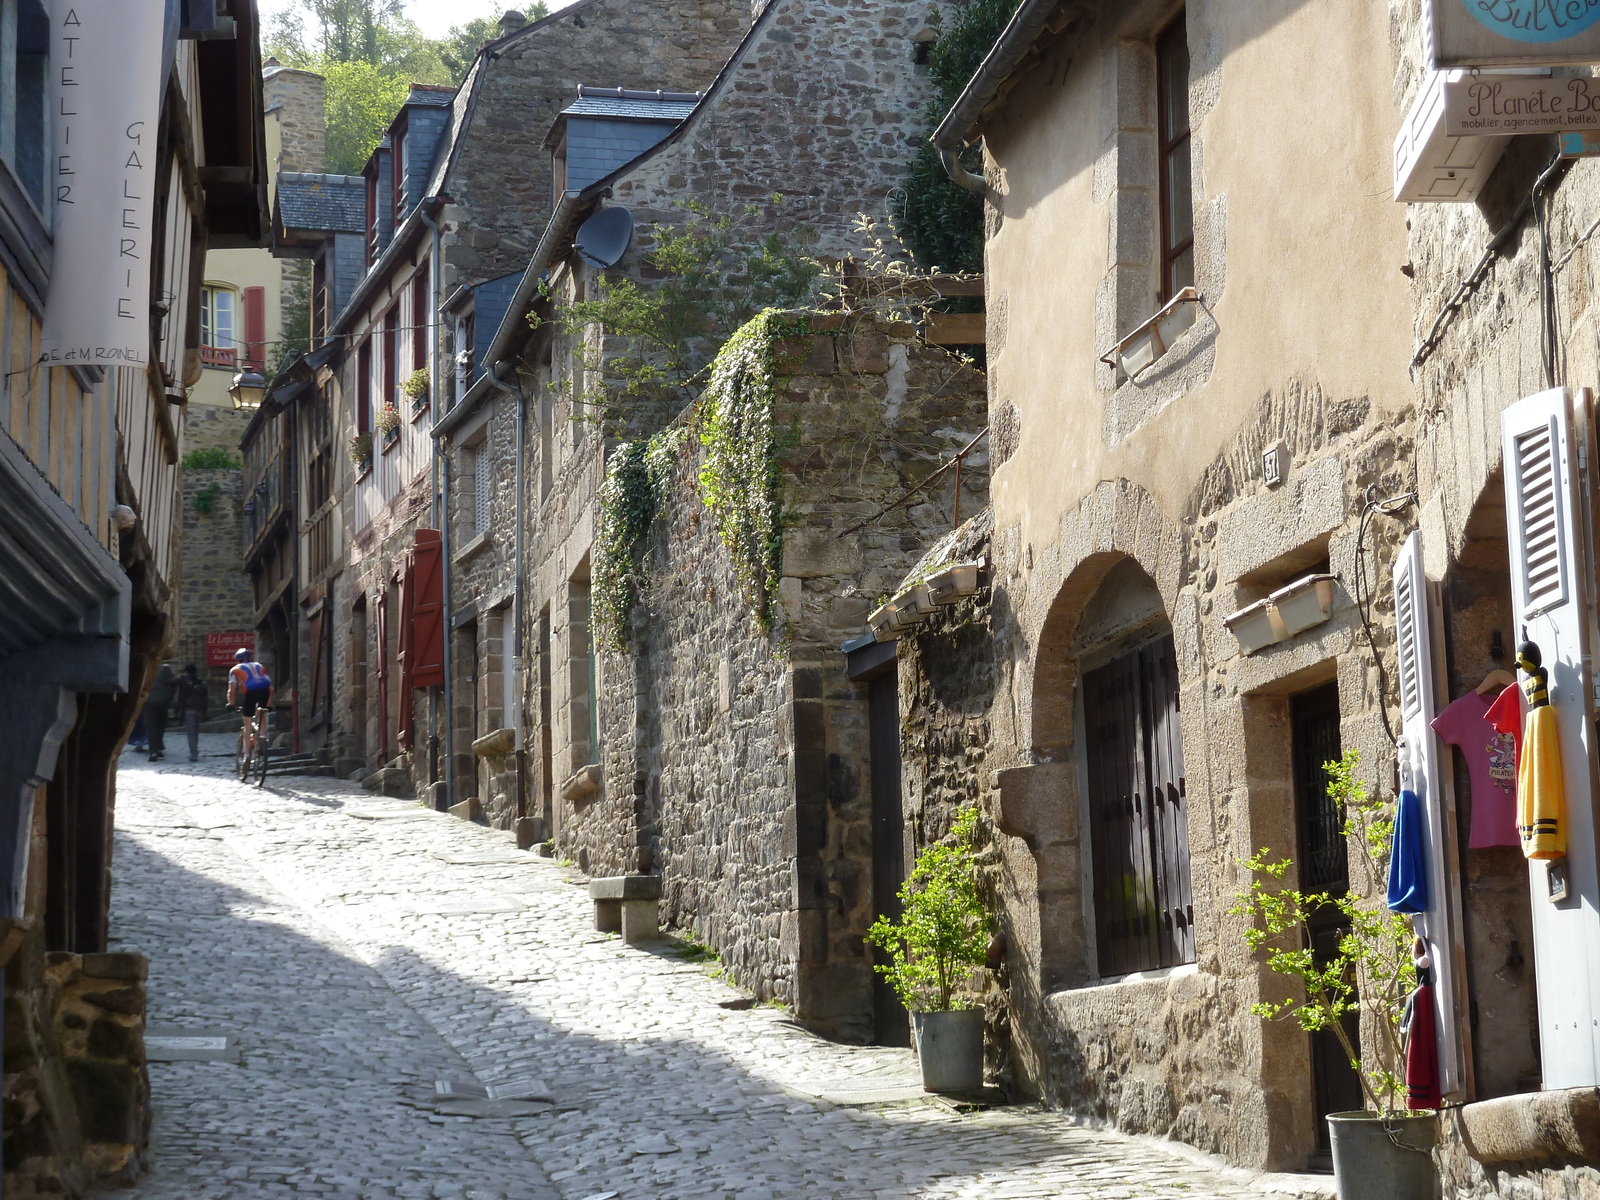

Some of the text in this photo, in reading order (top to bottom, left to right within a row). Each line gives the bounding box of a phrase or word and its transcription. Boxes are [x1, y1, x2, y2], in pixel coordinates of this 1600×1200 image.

[57, 8, 81, 205] ATELIER
[1567, 114, 1597, 124] belles
[118, 121, 145, 319] GALERIE
[65, 347, 77, 360] et
